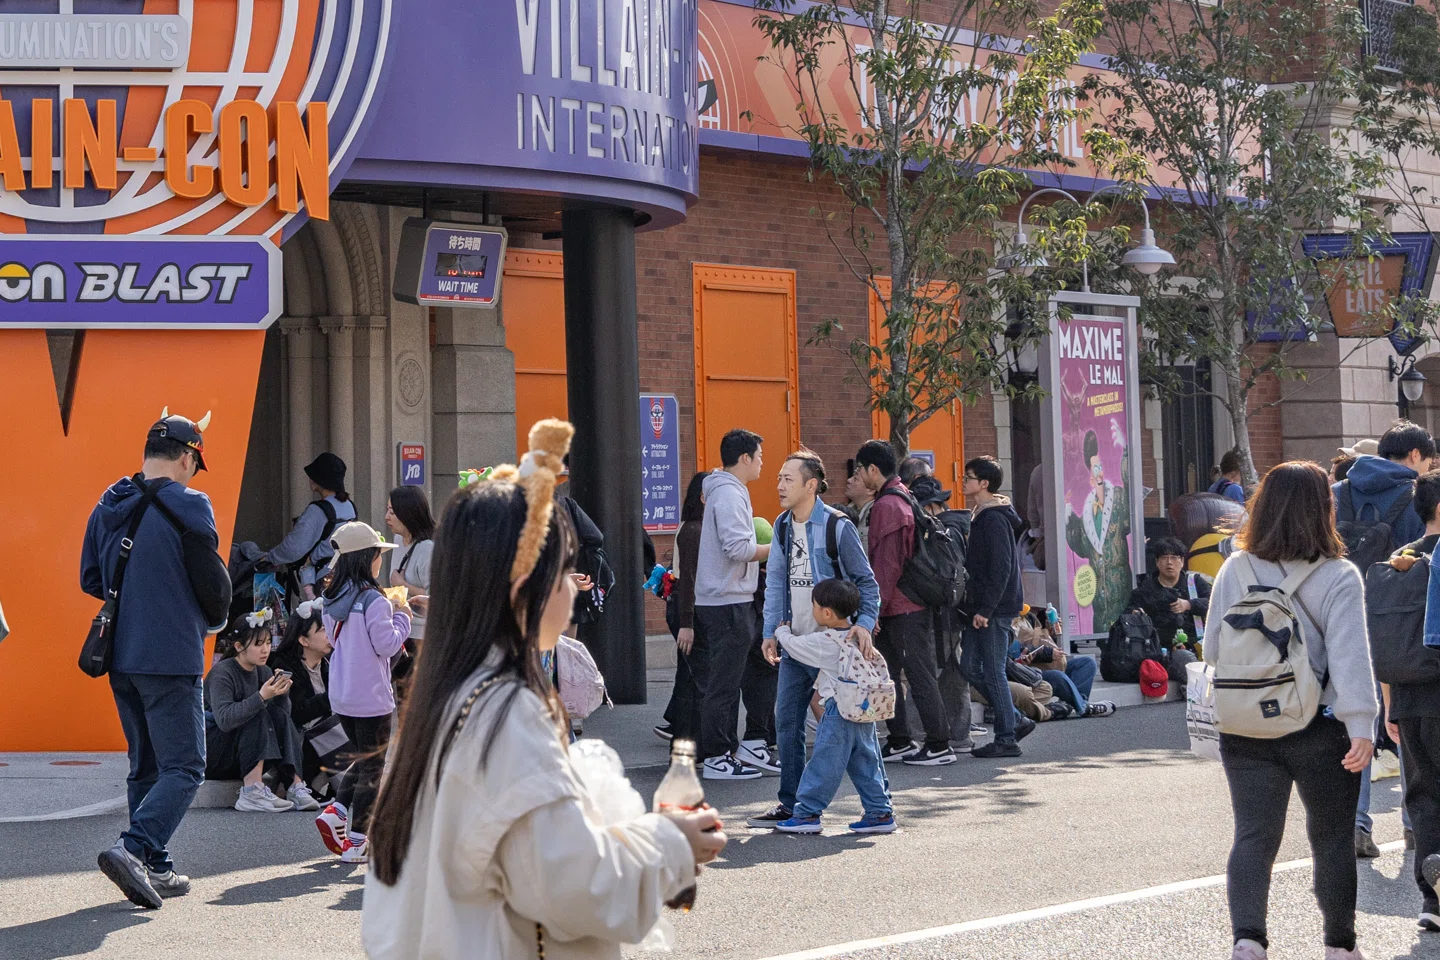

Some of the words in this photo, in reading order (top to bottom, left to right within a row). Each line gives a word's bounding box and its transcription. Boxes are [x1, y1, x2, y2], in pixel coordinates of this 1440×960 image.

[448, 235, 482, 251] 待ち時間
[75, 261, 253, 304] BLAST
[438, 280, 459, 293] WAIT
[460, 281, 479, 294] TIME
[1345, 288, 1385, 313] EATS
[1058, 325, 1123, 362] MAXIME
[1089, 364, 1101, 385] LE
[1103, 365, 1124, 386] MAL
[405, 464, 421, 481] JTB
